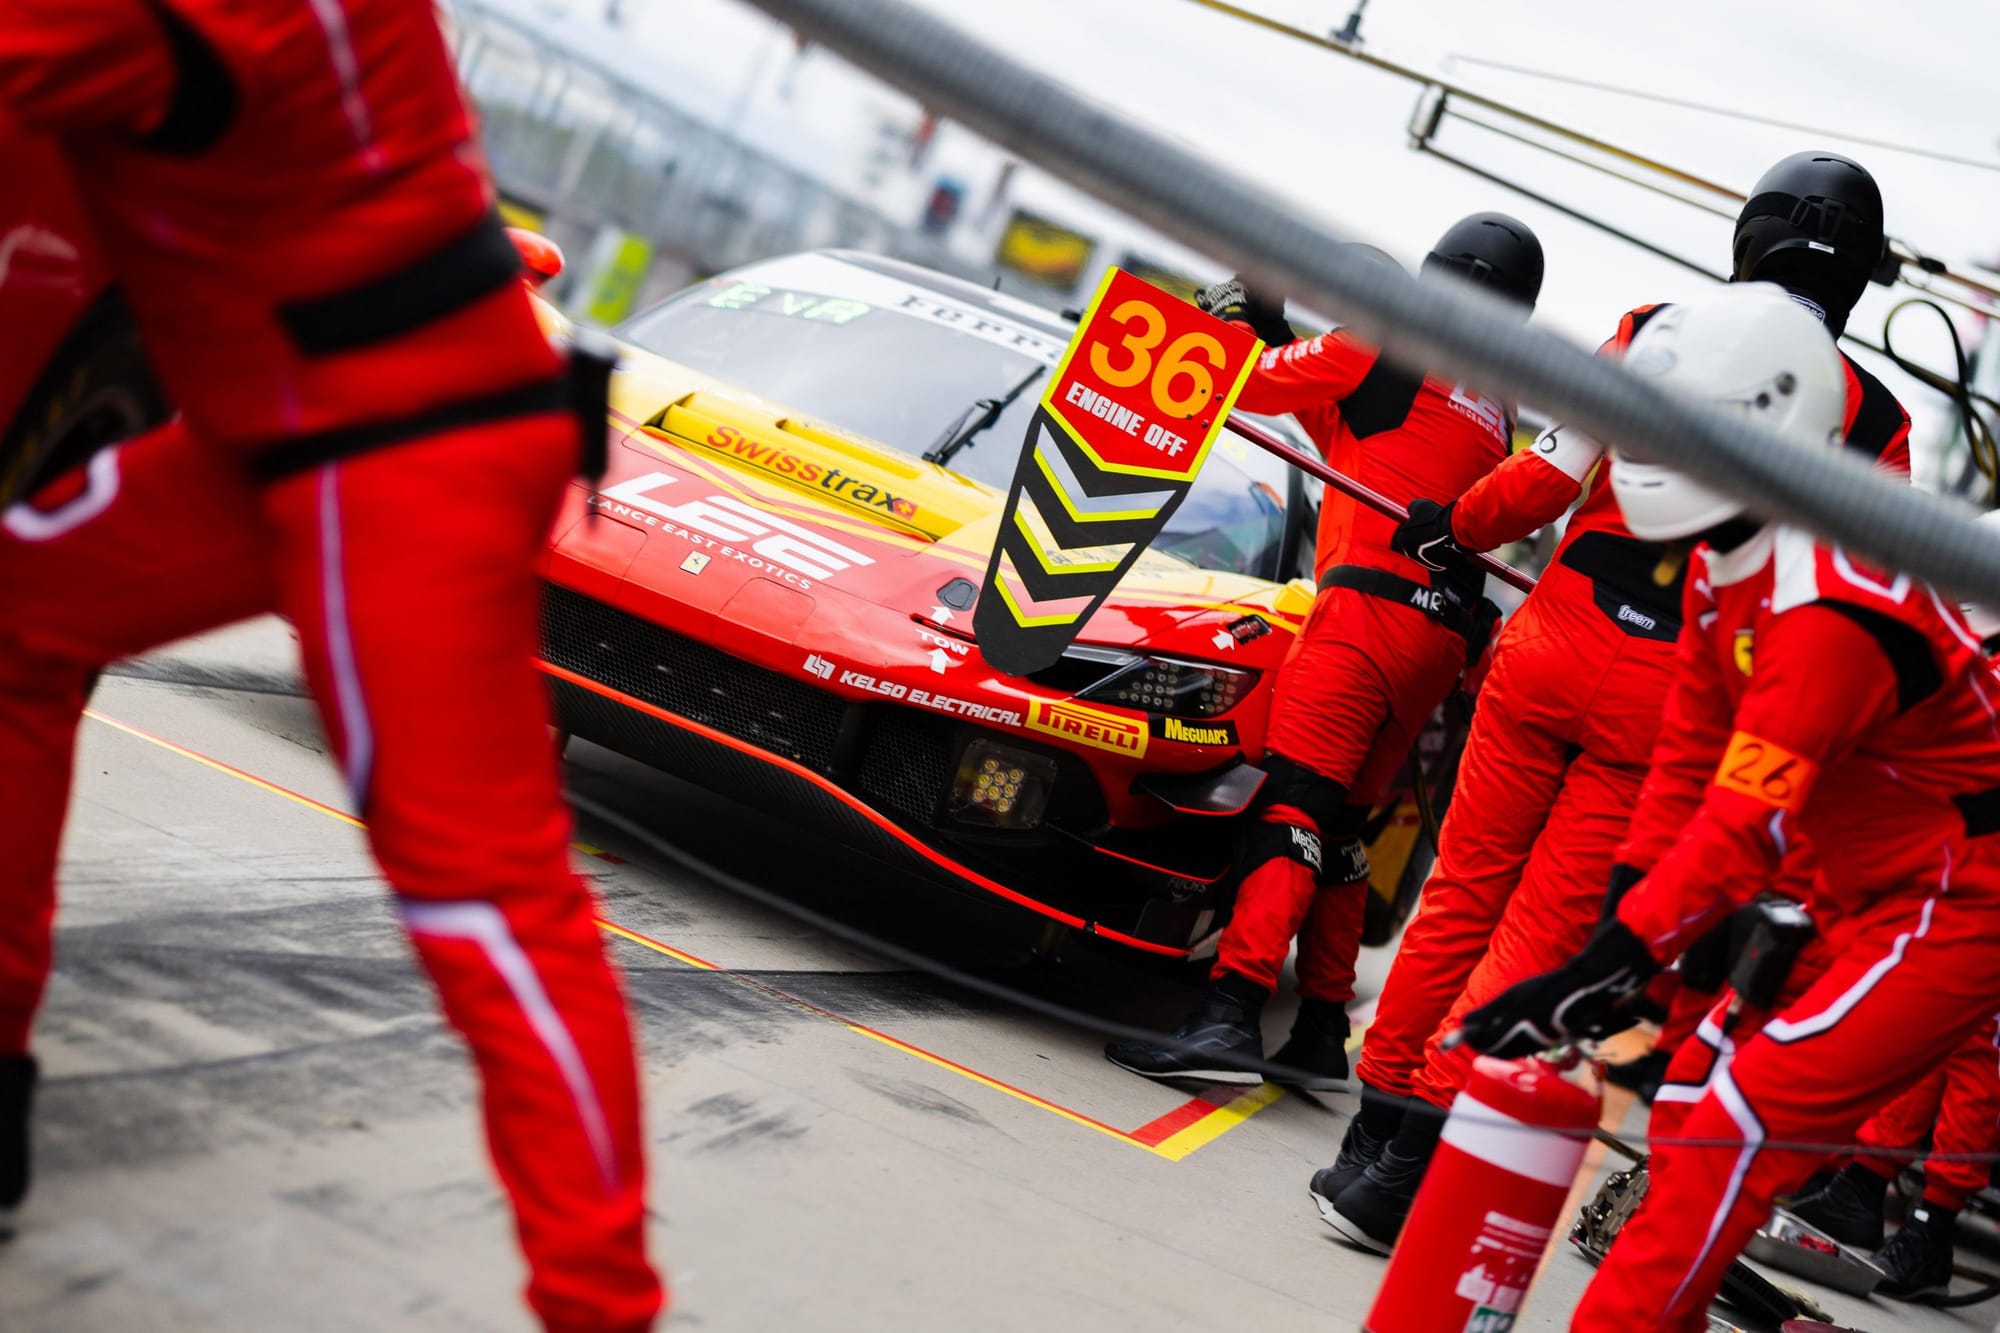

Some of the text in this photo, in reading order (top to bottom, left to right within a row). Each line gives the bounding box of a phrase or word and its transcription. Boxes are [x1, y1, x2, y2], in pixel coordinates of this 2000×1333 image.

[1089, 299, 1227, 419] 36
[1065, 381, 1145, 438] ENGINE
[1143, 423, 1188, 457] OFF
[706, 425, 901, 514] Swisstrax
[587, 495, 813, 590] LANCE EAST EXOTICS
[599, 471, 877, 581] LEE
[915, 628, 970, 656] TOW
[839, 669, 1022, 727] KELSO ELECTRICAL
[1037, 700, 1140, 751] PIRELLI
[1727, 741, 1797, 799] 26
